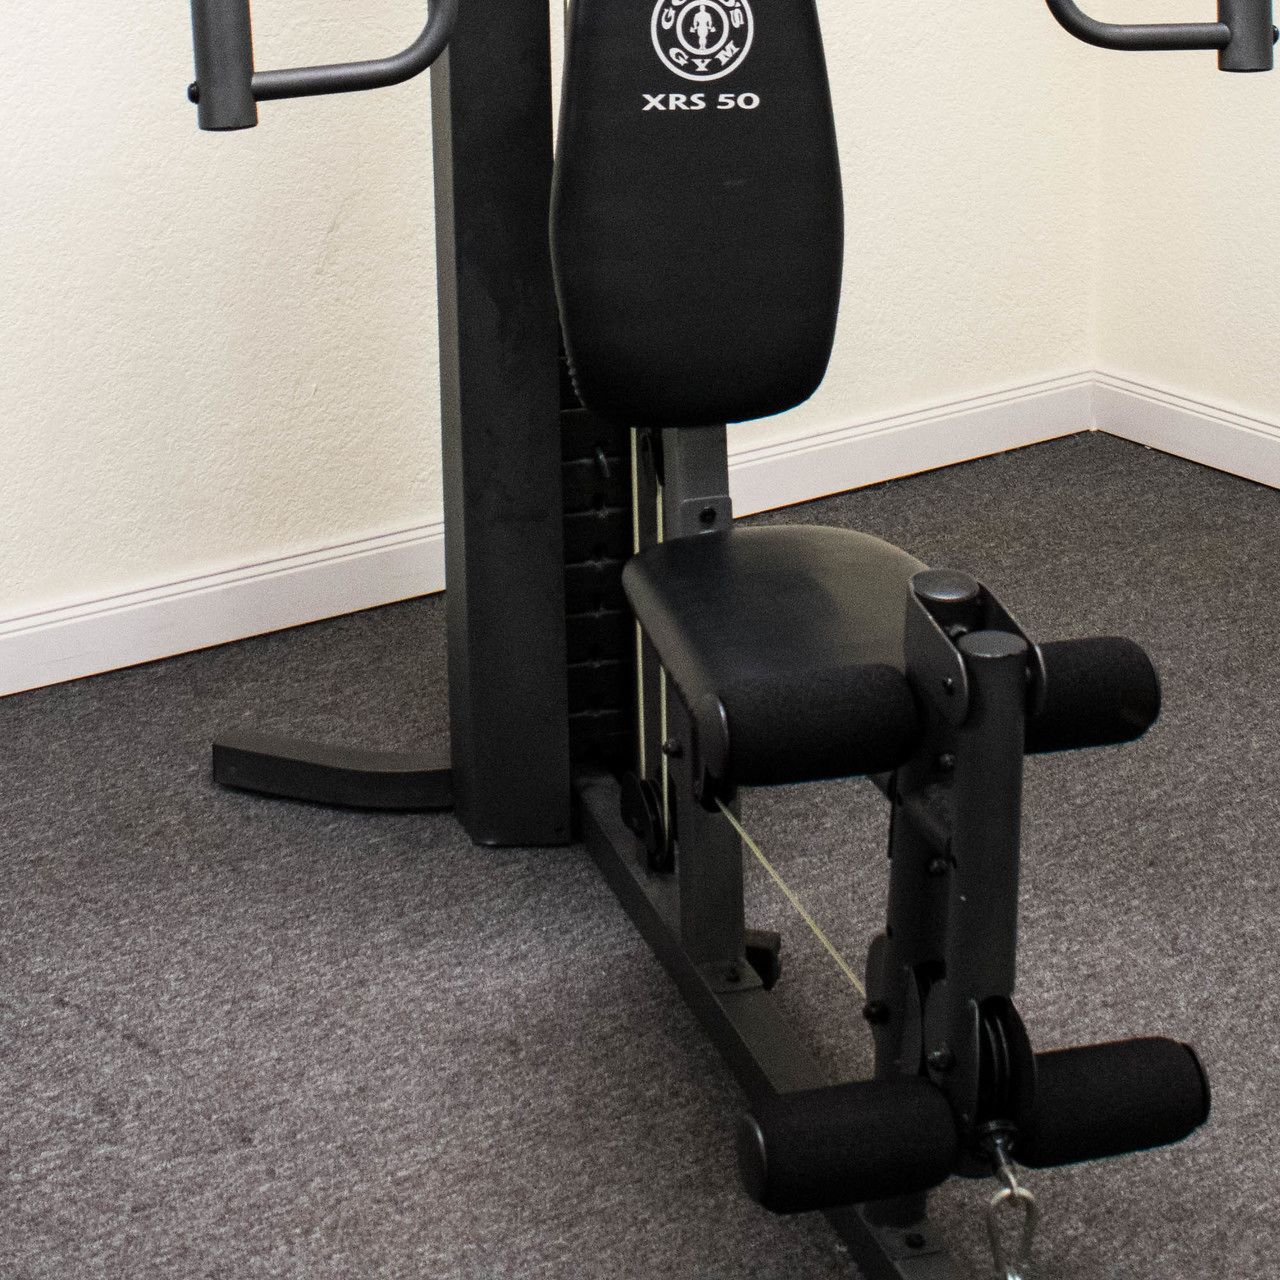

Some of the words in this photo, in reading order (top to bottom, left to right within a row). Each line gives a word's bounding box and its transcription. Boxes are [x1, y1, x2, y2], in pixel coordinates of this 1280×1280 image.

[669, 40, 740, 71] GYM
[641, 93, 706, 111] XRS
[716, 92, 760, 110] 50
